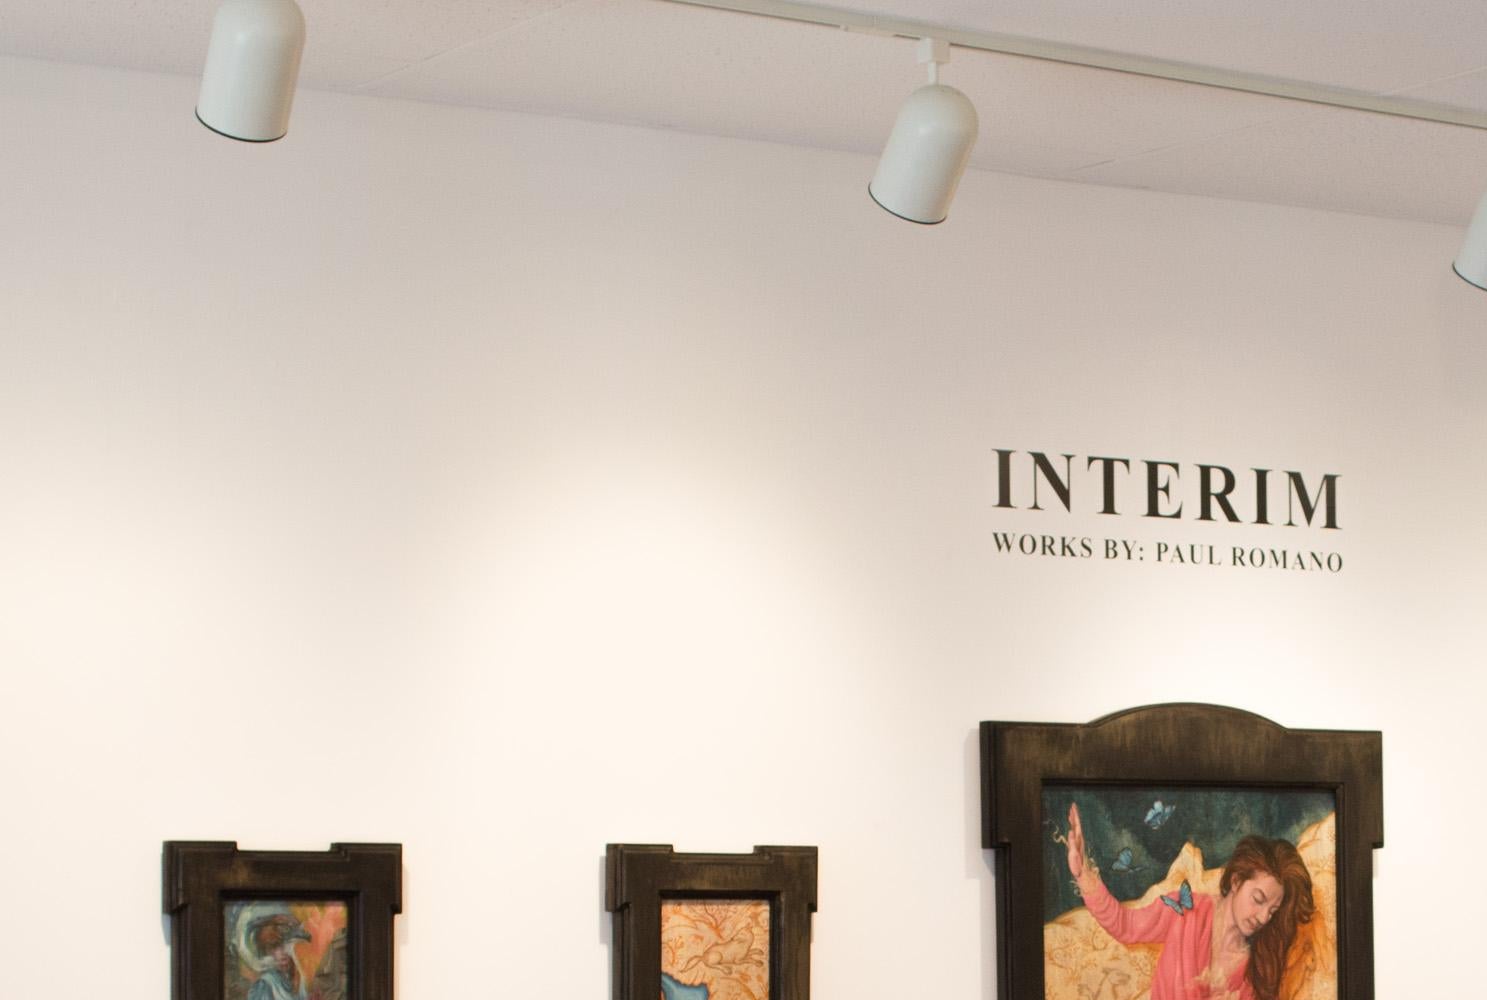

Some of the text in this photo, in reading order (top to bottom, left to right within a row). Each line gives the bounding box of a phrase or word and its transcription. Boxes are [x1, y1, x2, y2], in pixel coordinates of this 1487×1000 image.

[991, 448, 1343, 530] INTERIM
[992, 531, 1343, 573] WORKS BY: PAUL ROMANO
